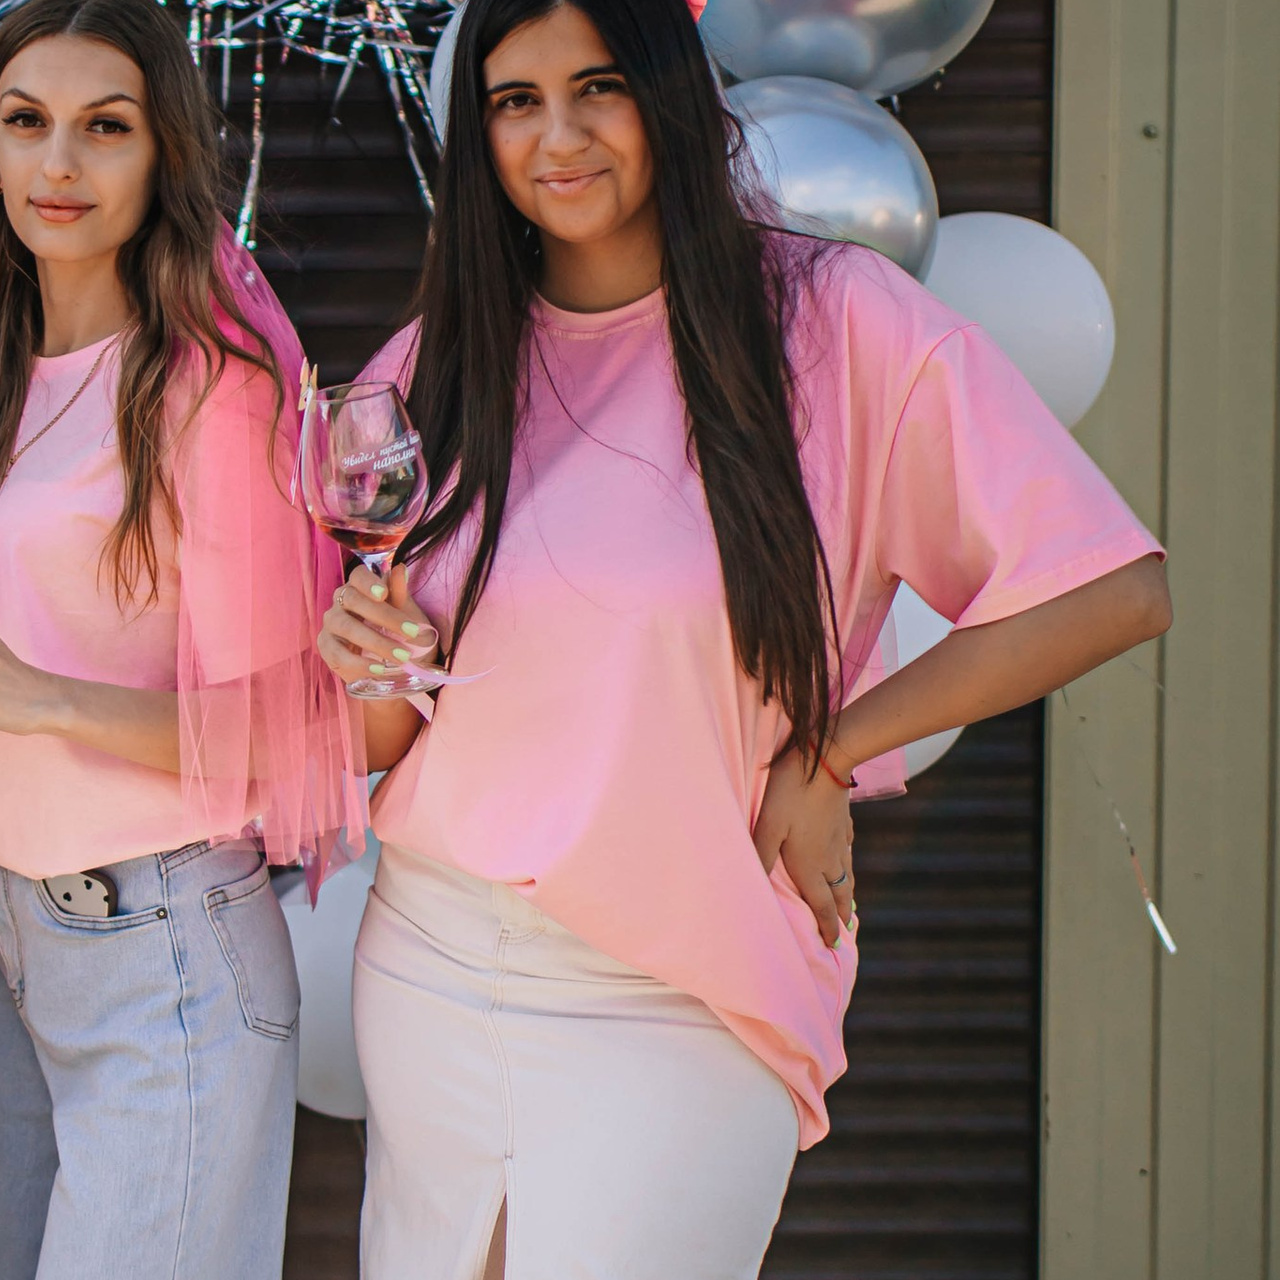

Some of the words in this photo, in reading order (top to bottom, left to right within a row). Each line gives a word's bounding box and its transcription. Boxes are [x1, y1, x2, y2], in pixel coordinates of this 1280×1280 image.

[342, 452, 376, 468] Увидел
[380, 438, 408, 457] пустой
[373, 447, 417, 470] наполни
